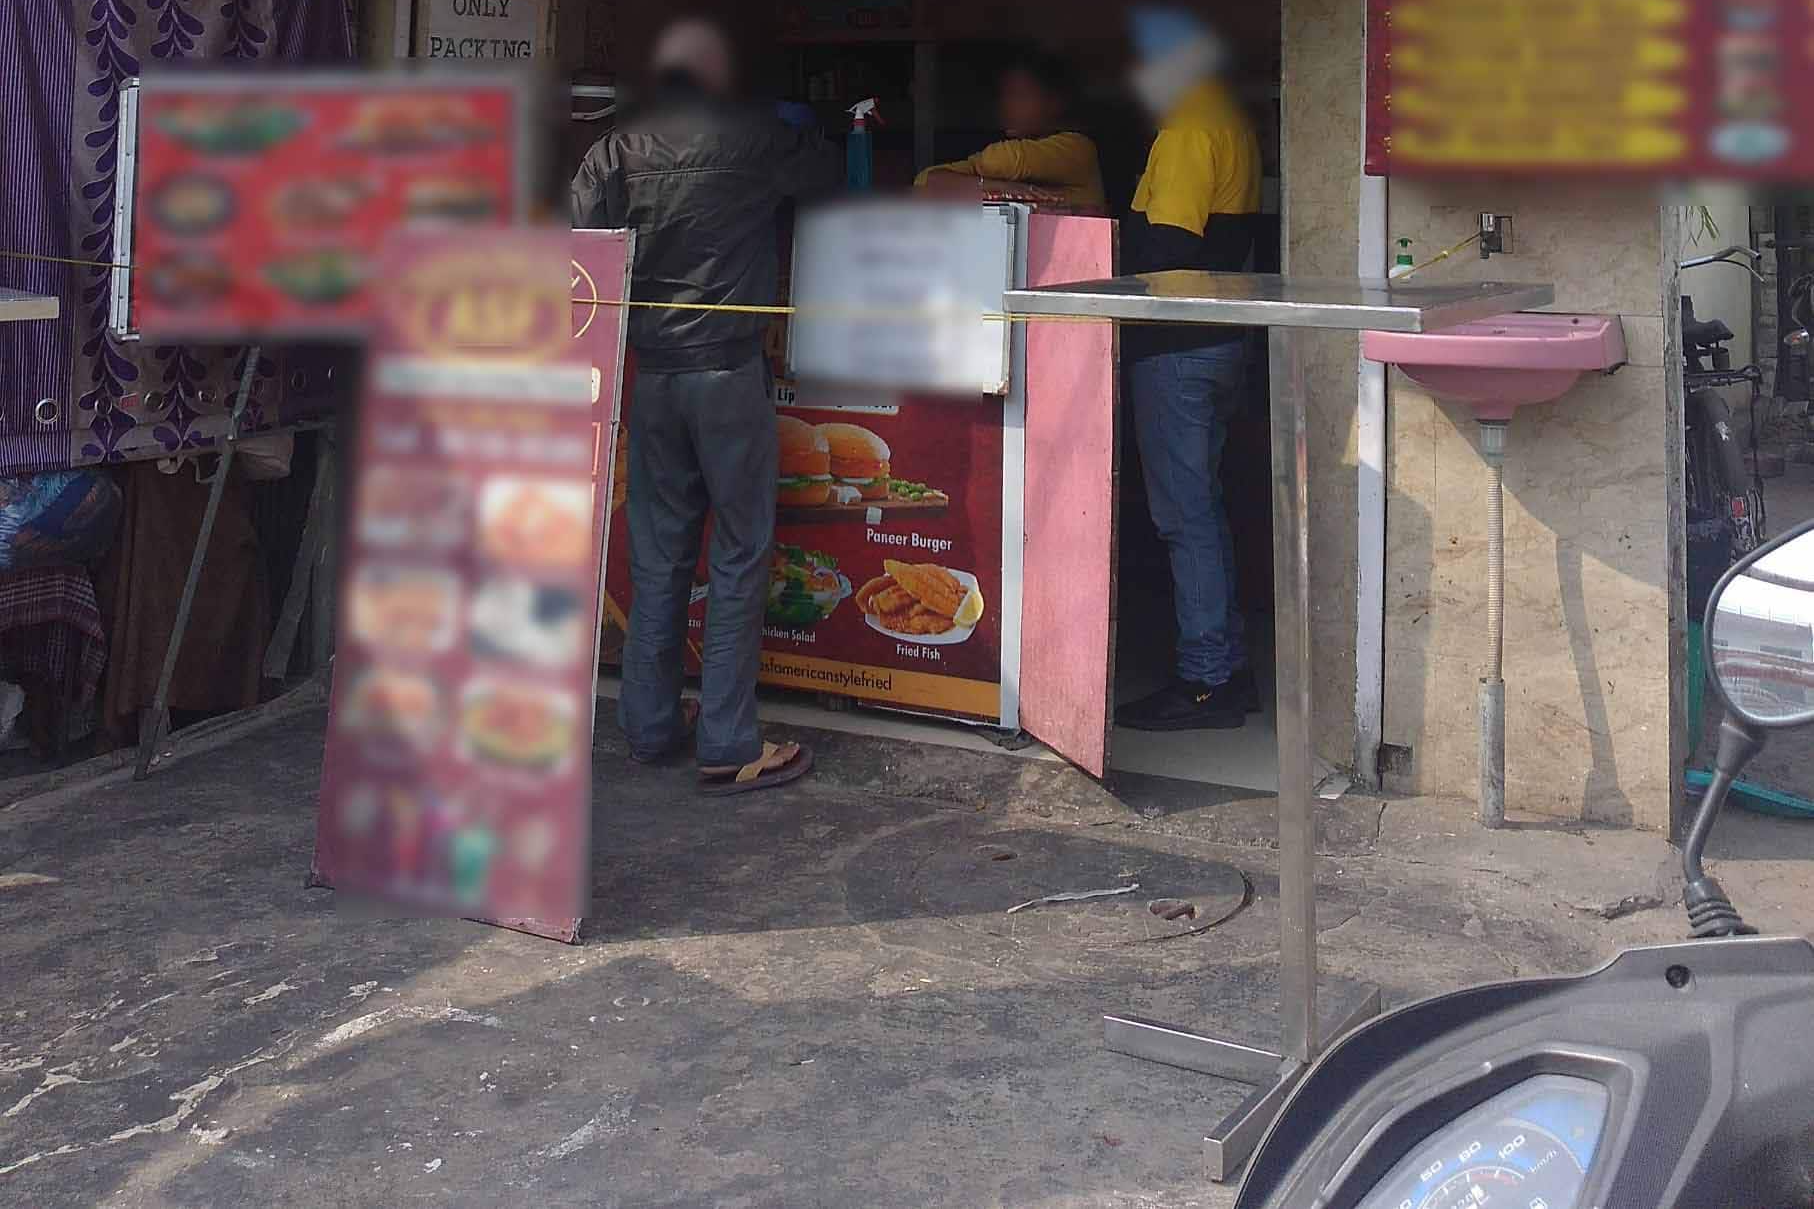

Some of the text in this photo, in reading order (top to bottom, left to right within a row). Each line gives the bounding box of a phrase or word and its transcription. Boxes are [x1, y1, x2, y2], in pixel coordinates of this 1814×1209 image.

[429, 36, 531, 59] PACKING
[866, 528, 953, 553] Paneer Burger
[760, 626, 816, 643] hicken Salad
[896, 643, 941, 661] Fried Fish
[1458, 1141, 1481, 1162] 80
[1498, 1134, 1526, 1159] 100
